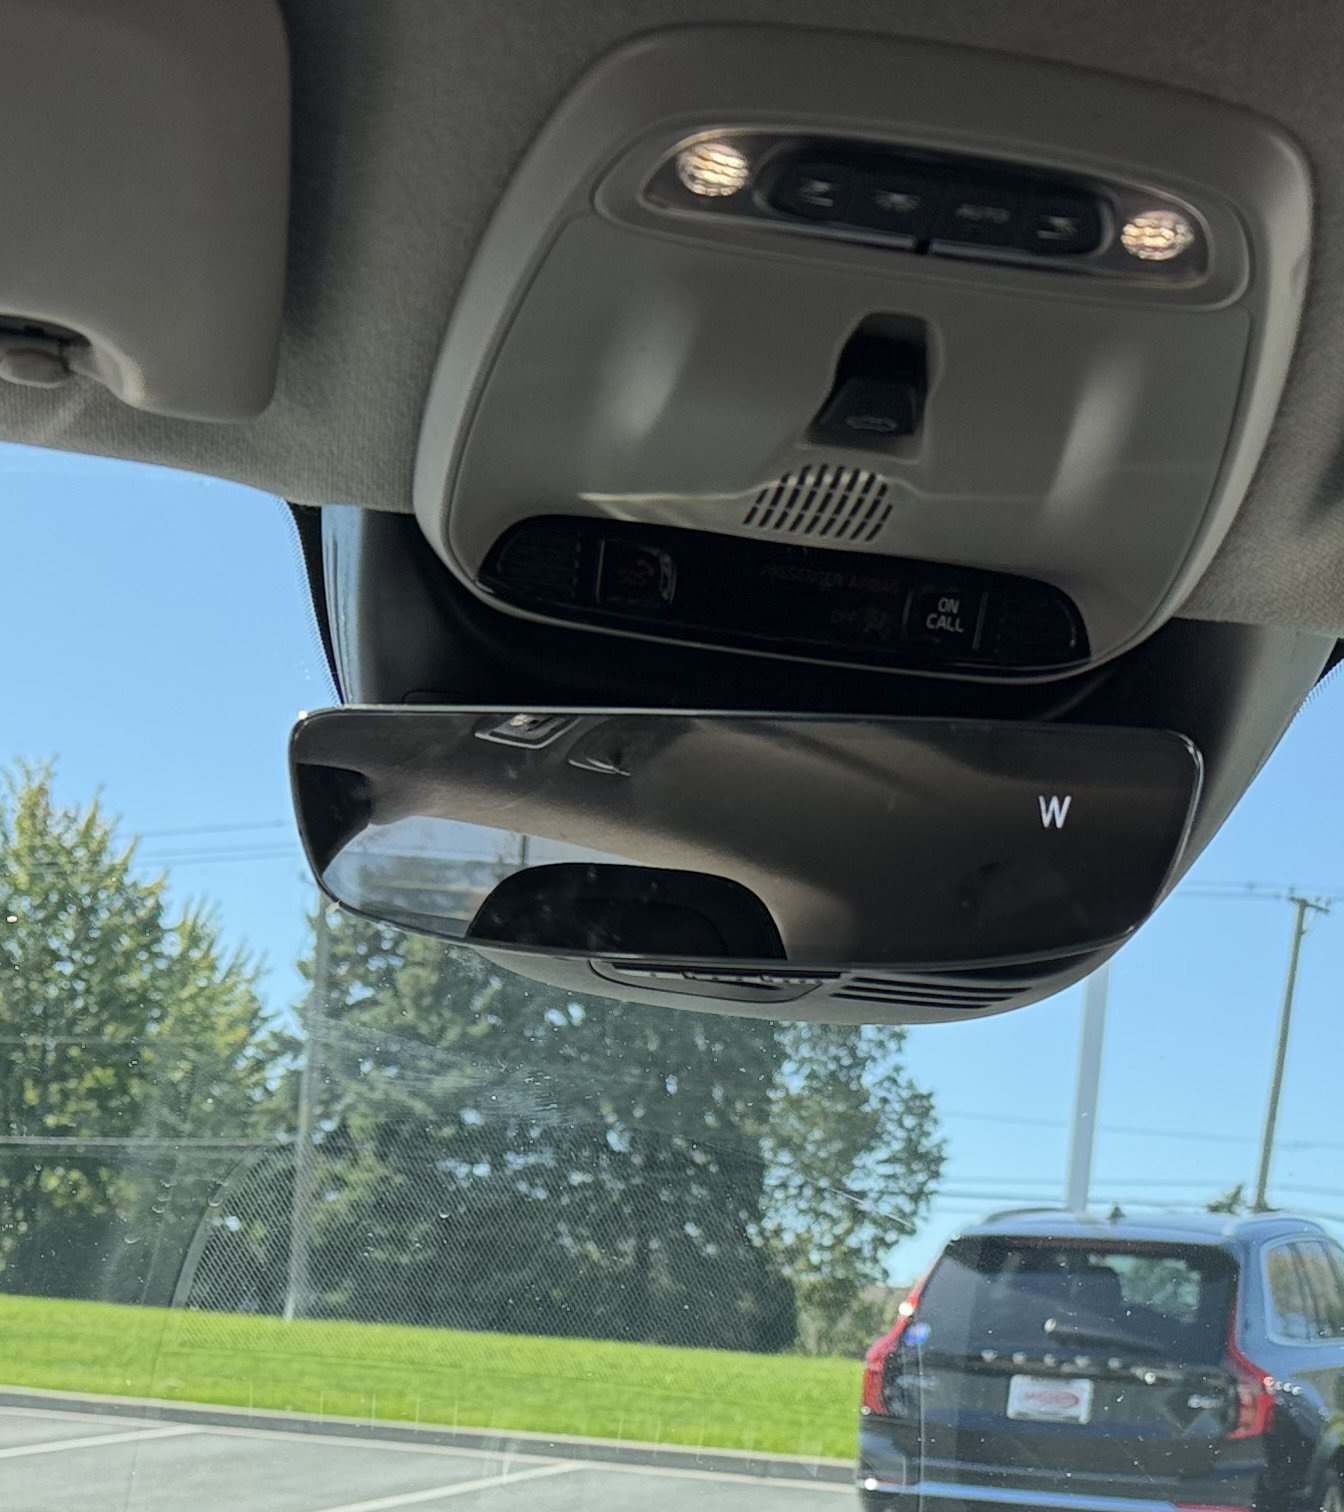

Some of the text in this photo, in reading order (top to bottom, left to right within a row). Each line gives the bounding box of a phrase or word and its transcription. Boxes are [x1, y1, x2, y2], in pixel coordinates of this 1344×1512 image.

[938, 597, 960, 614] ON
[927, 612, 964, 634] CALL
[1038, 795, 1072, 829] W
